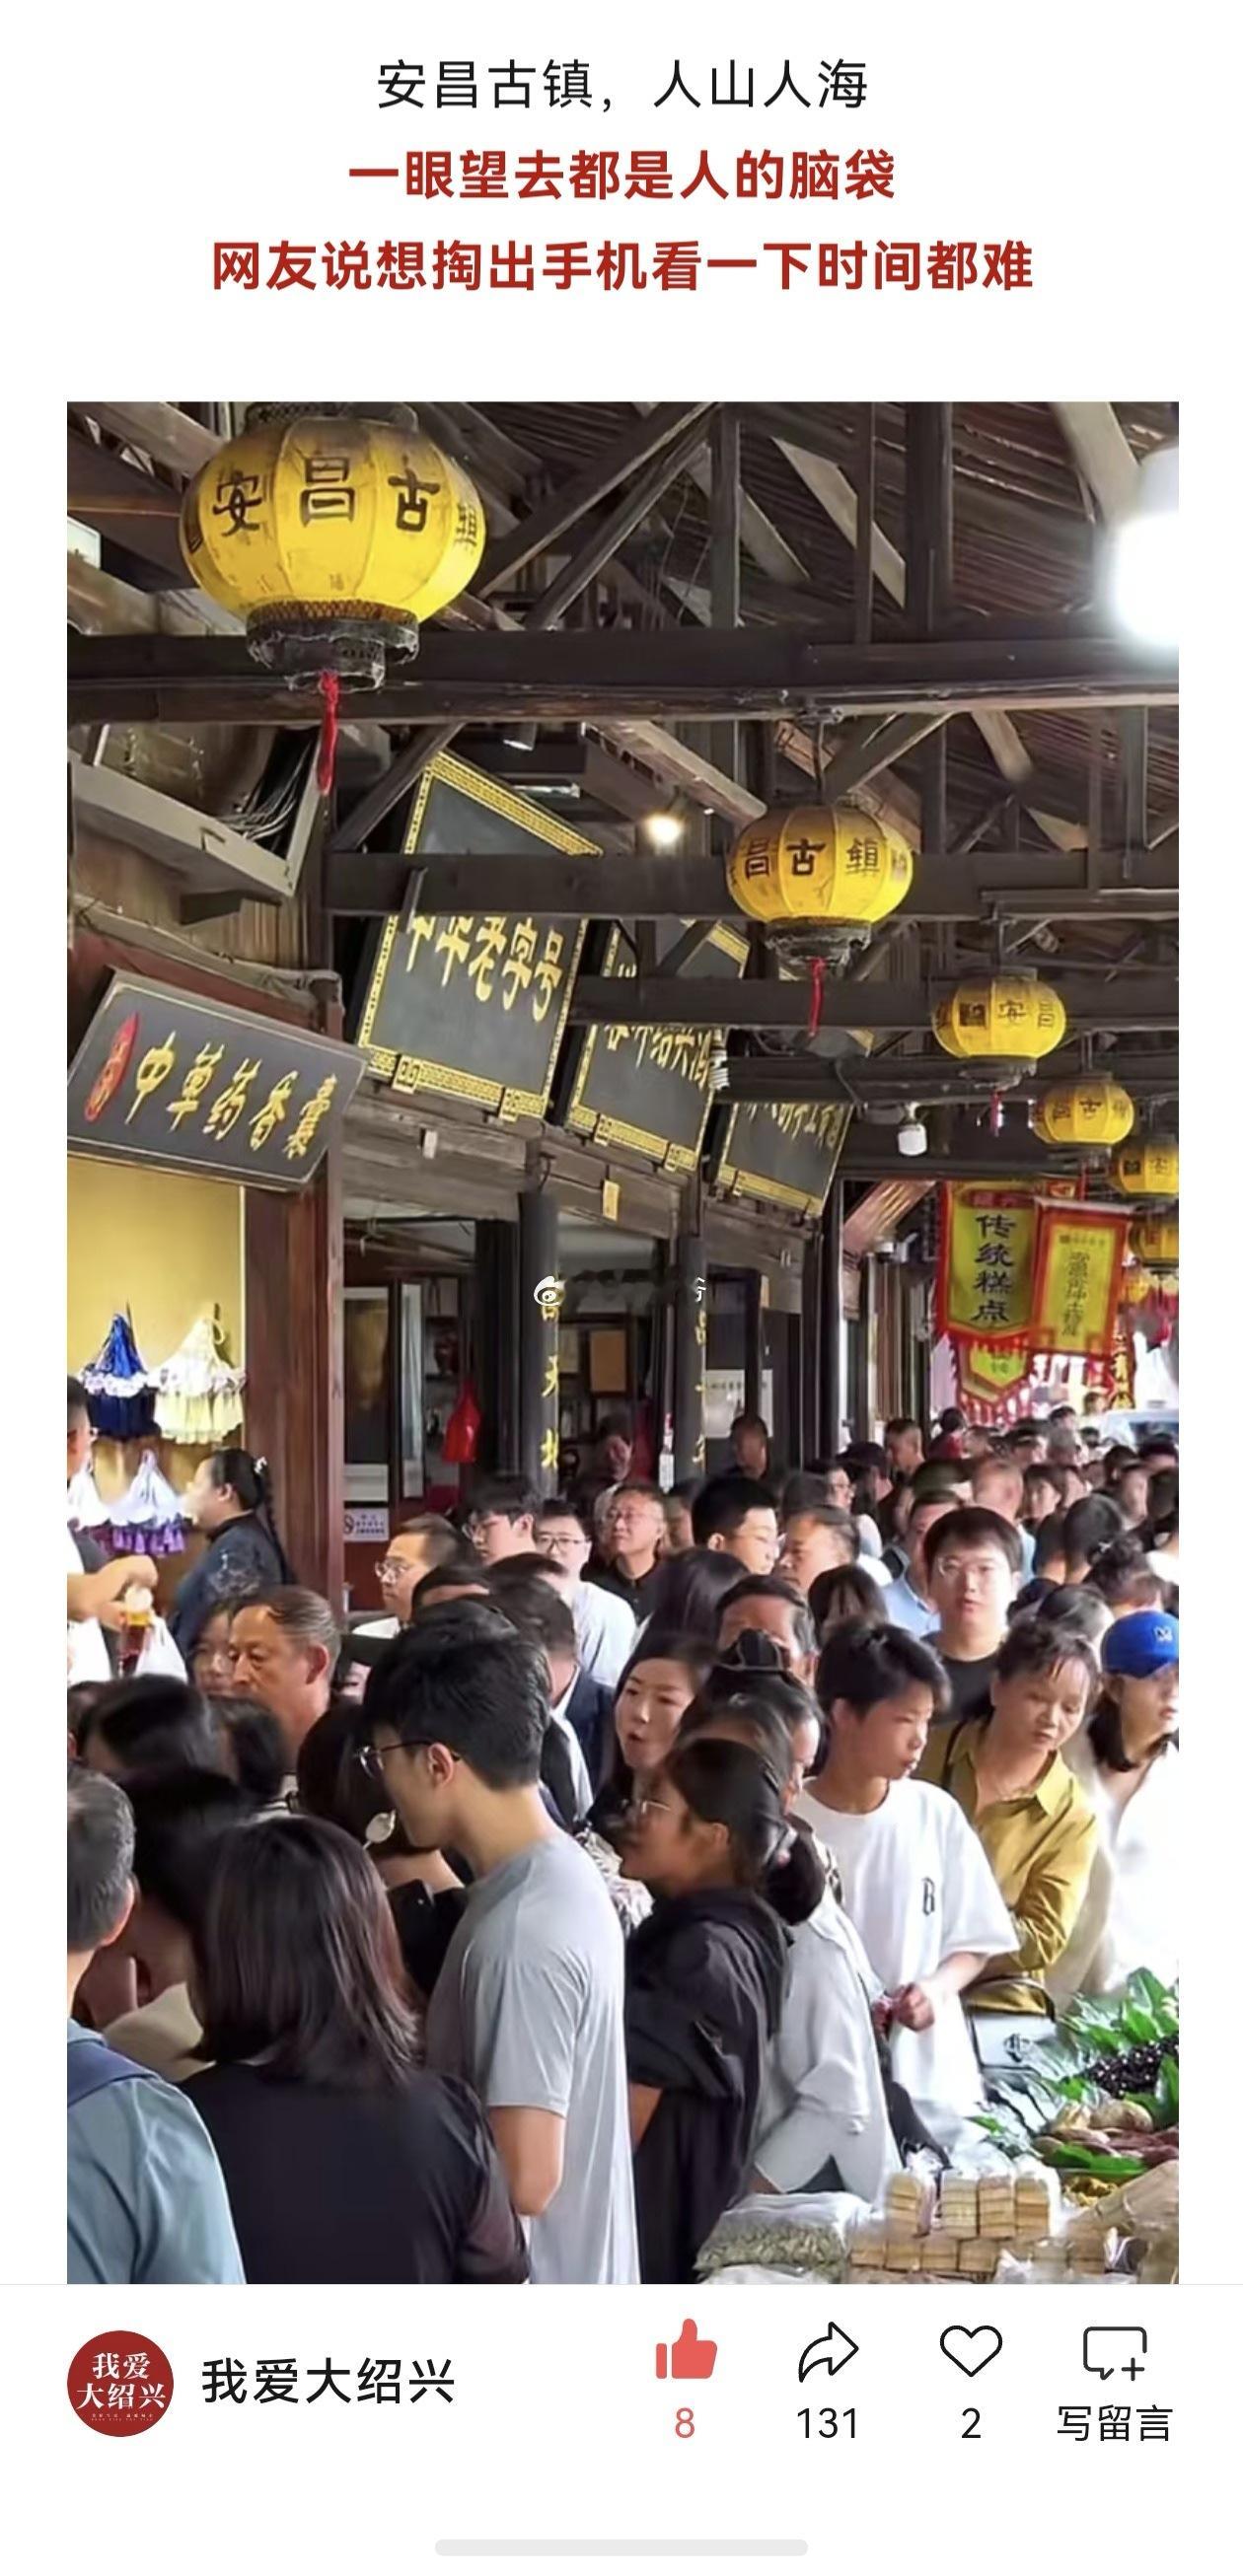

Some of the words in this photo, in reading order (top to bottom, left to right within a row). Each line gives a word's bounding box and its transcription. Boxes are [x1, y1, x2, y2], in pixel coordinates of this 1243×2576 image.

[124, 1030, 338, 1161] 中草药香囊
[971, 1214, 1017, 1324] 传统糕点
